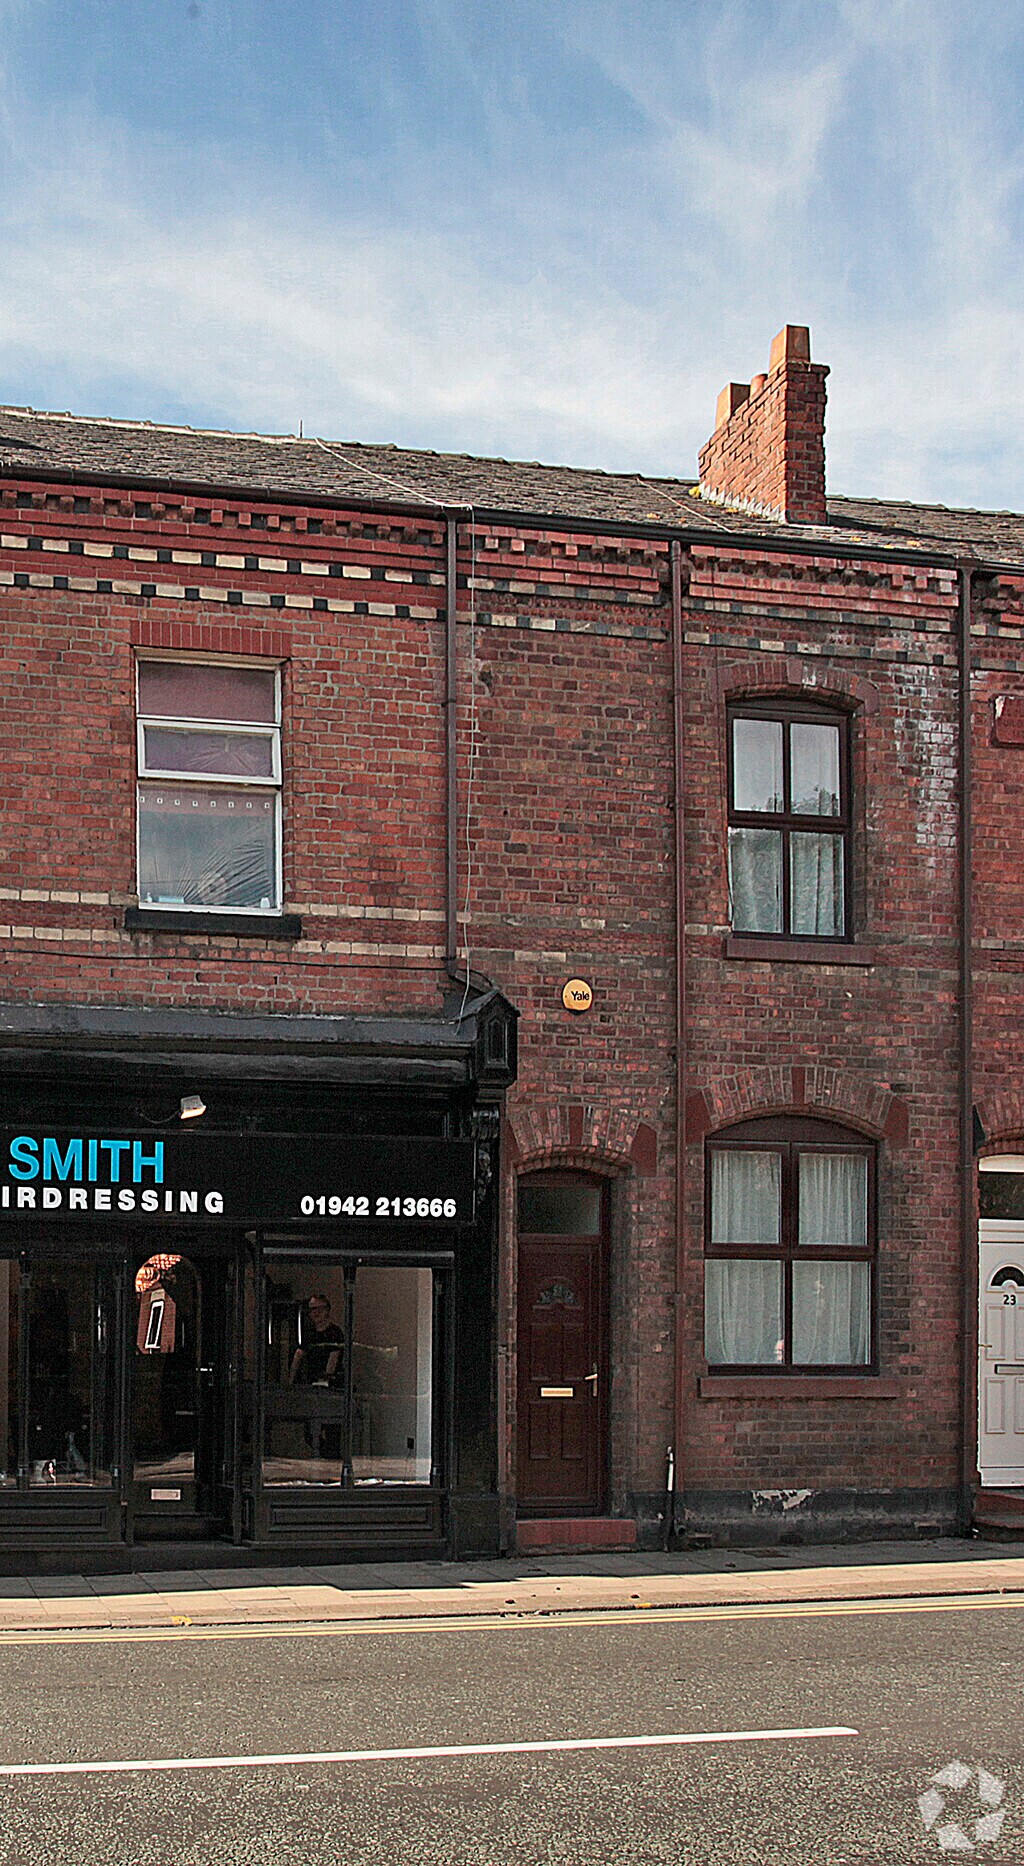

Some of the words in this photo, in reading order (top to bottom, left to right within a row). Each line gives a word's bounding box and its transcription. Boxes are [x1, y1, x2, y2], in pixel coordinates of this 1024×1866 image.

[571, 991, 589, 1001] Yale
[9, 1136, 164, 1183] SMITH
[301, 1195, 369, 1216] 01942
[376, 1197, 456, 1217] 213666
[1003, 1294, 1017, 1306] 23
